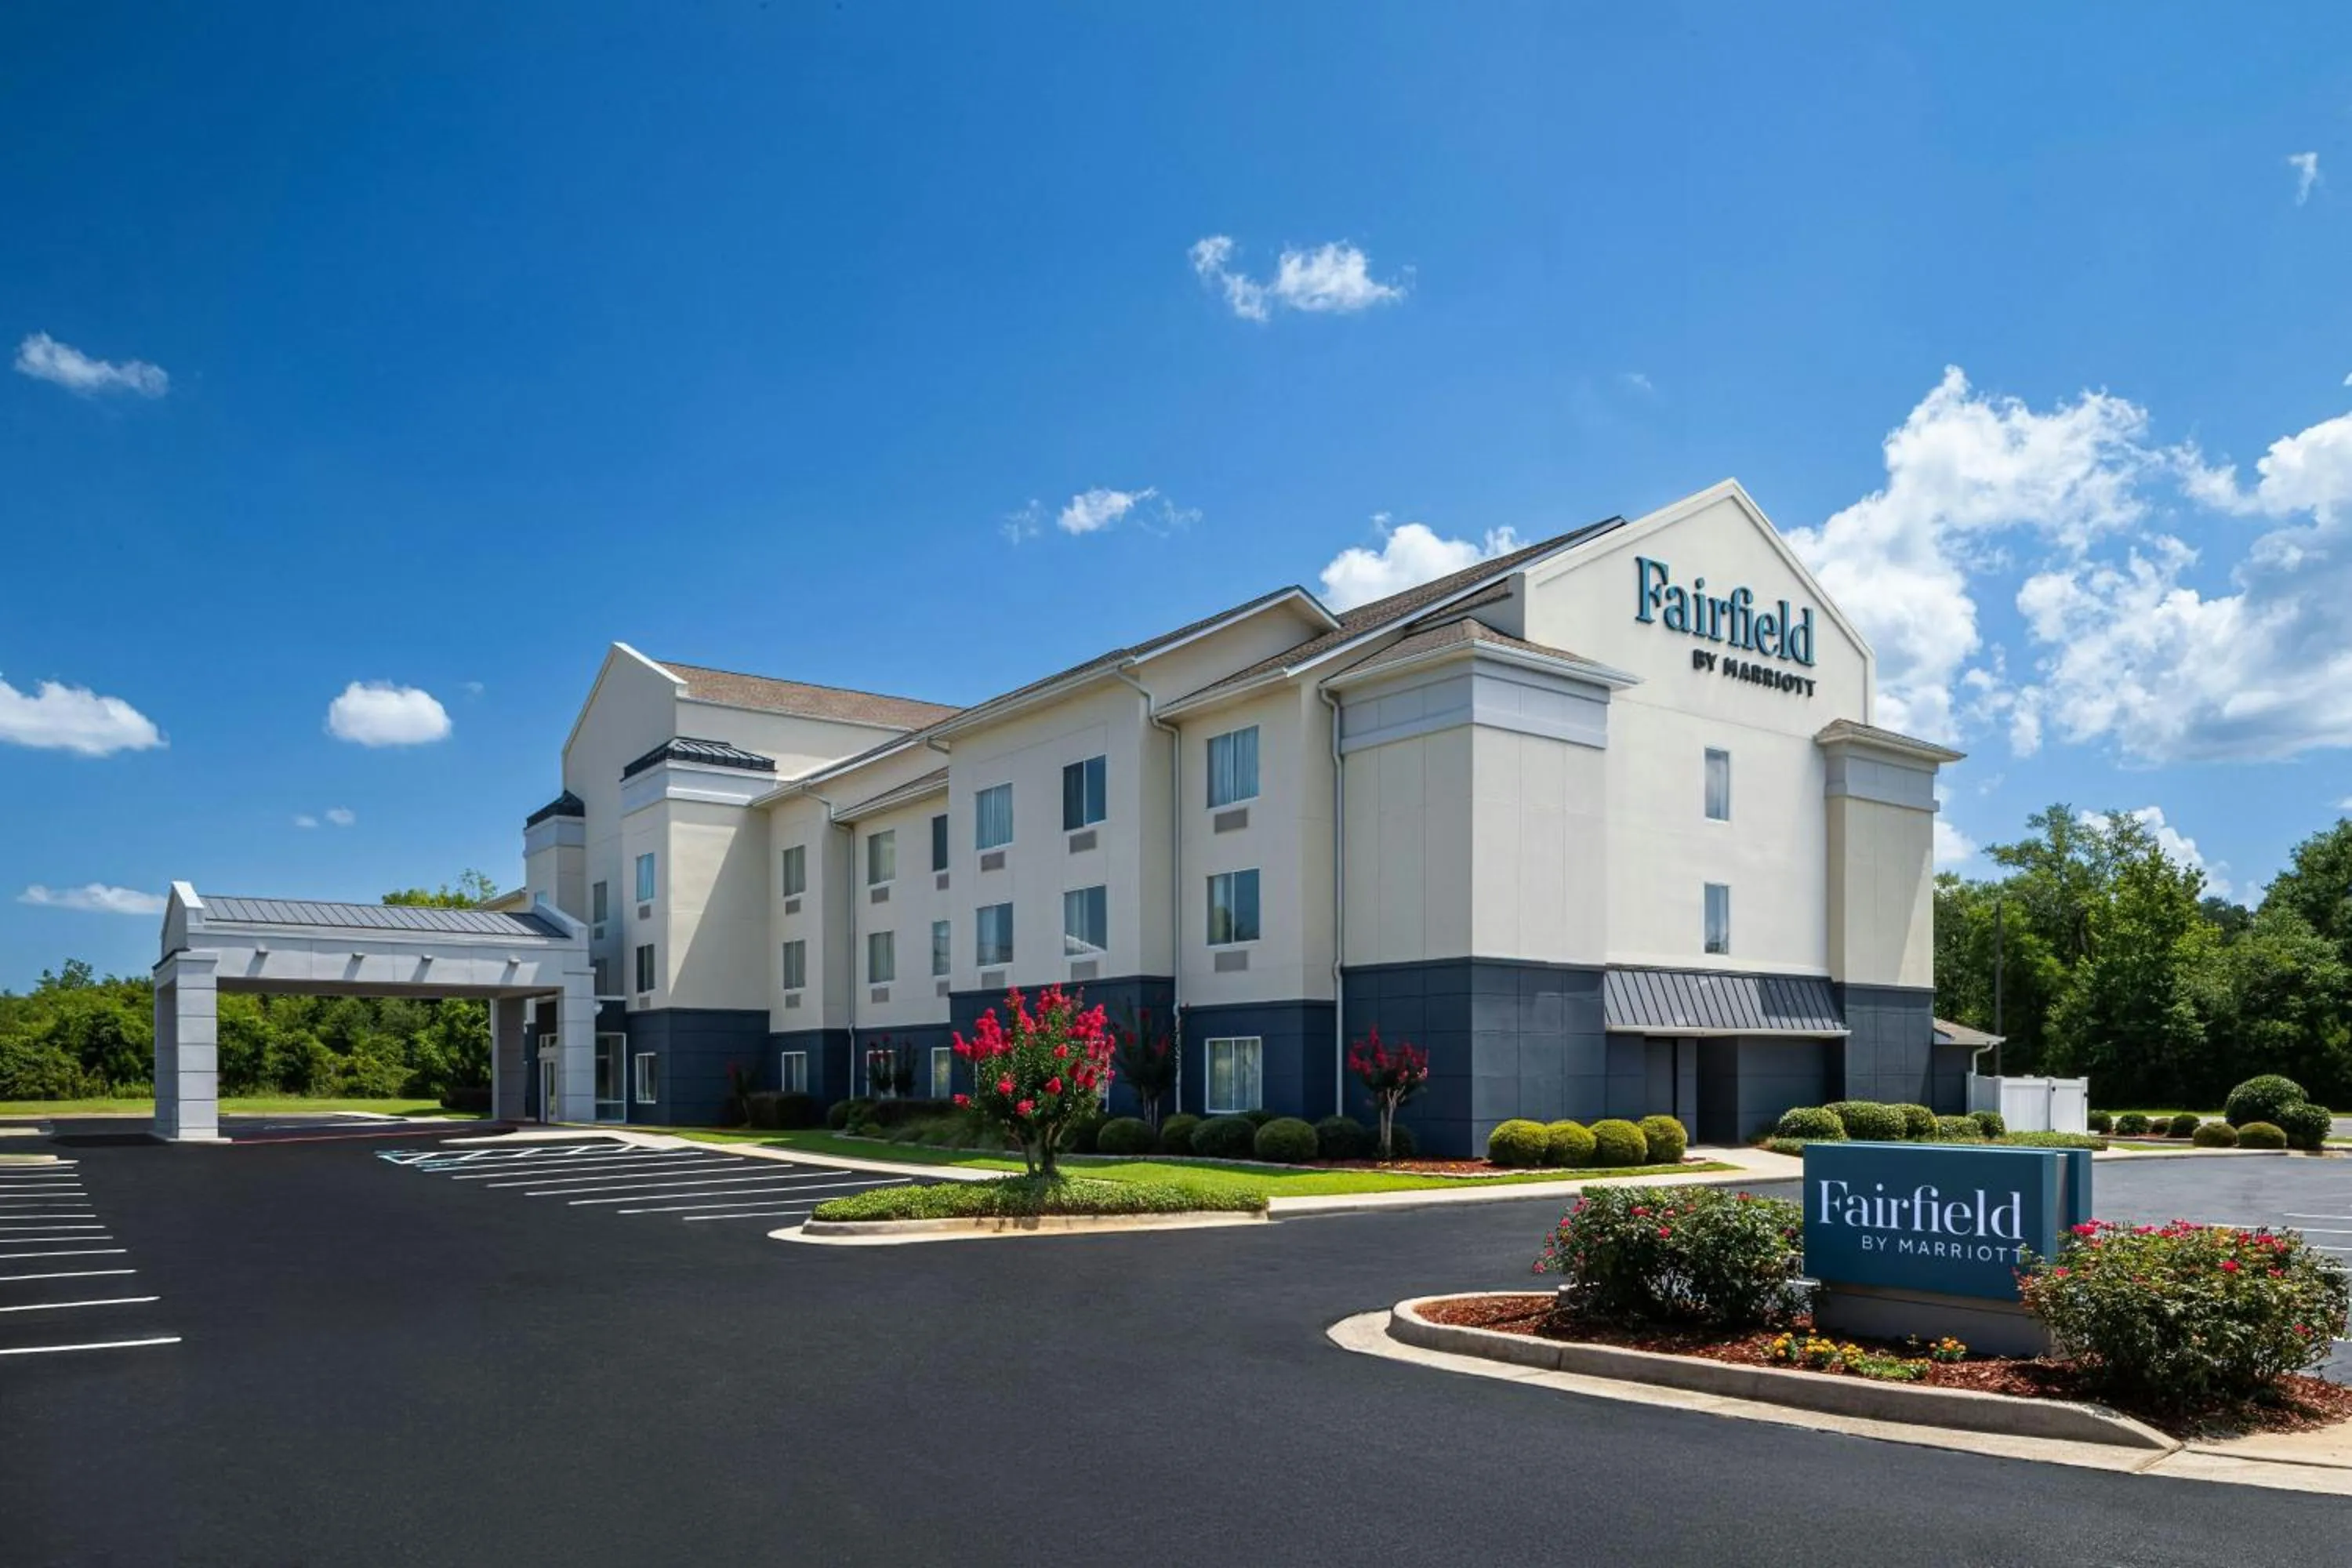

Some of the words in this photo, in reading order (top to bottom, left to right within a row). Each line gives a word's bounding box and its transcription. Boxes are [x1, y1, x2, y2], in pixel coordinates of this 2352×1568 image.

[1635, 556, 1817, 667] Fairfield
[1693, 648, 1718, 672] BY
[1722, 656, 1817, 698] MARRIOTT
[1818, 1180, 2024, 1240] Fairfield
[1861, 1235, 1888, 1252] BY
[1898, 1237, 2023, 1264] MARRIOTT
